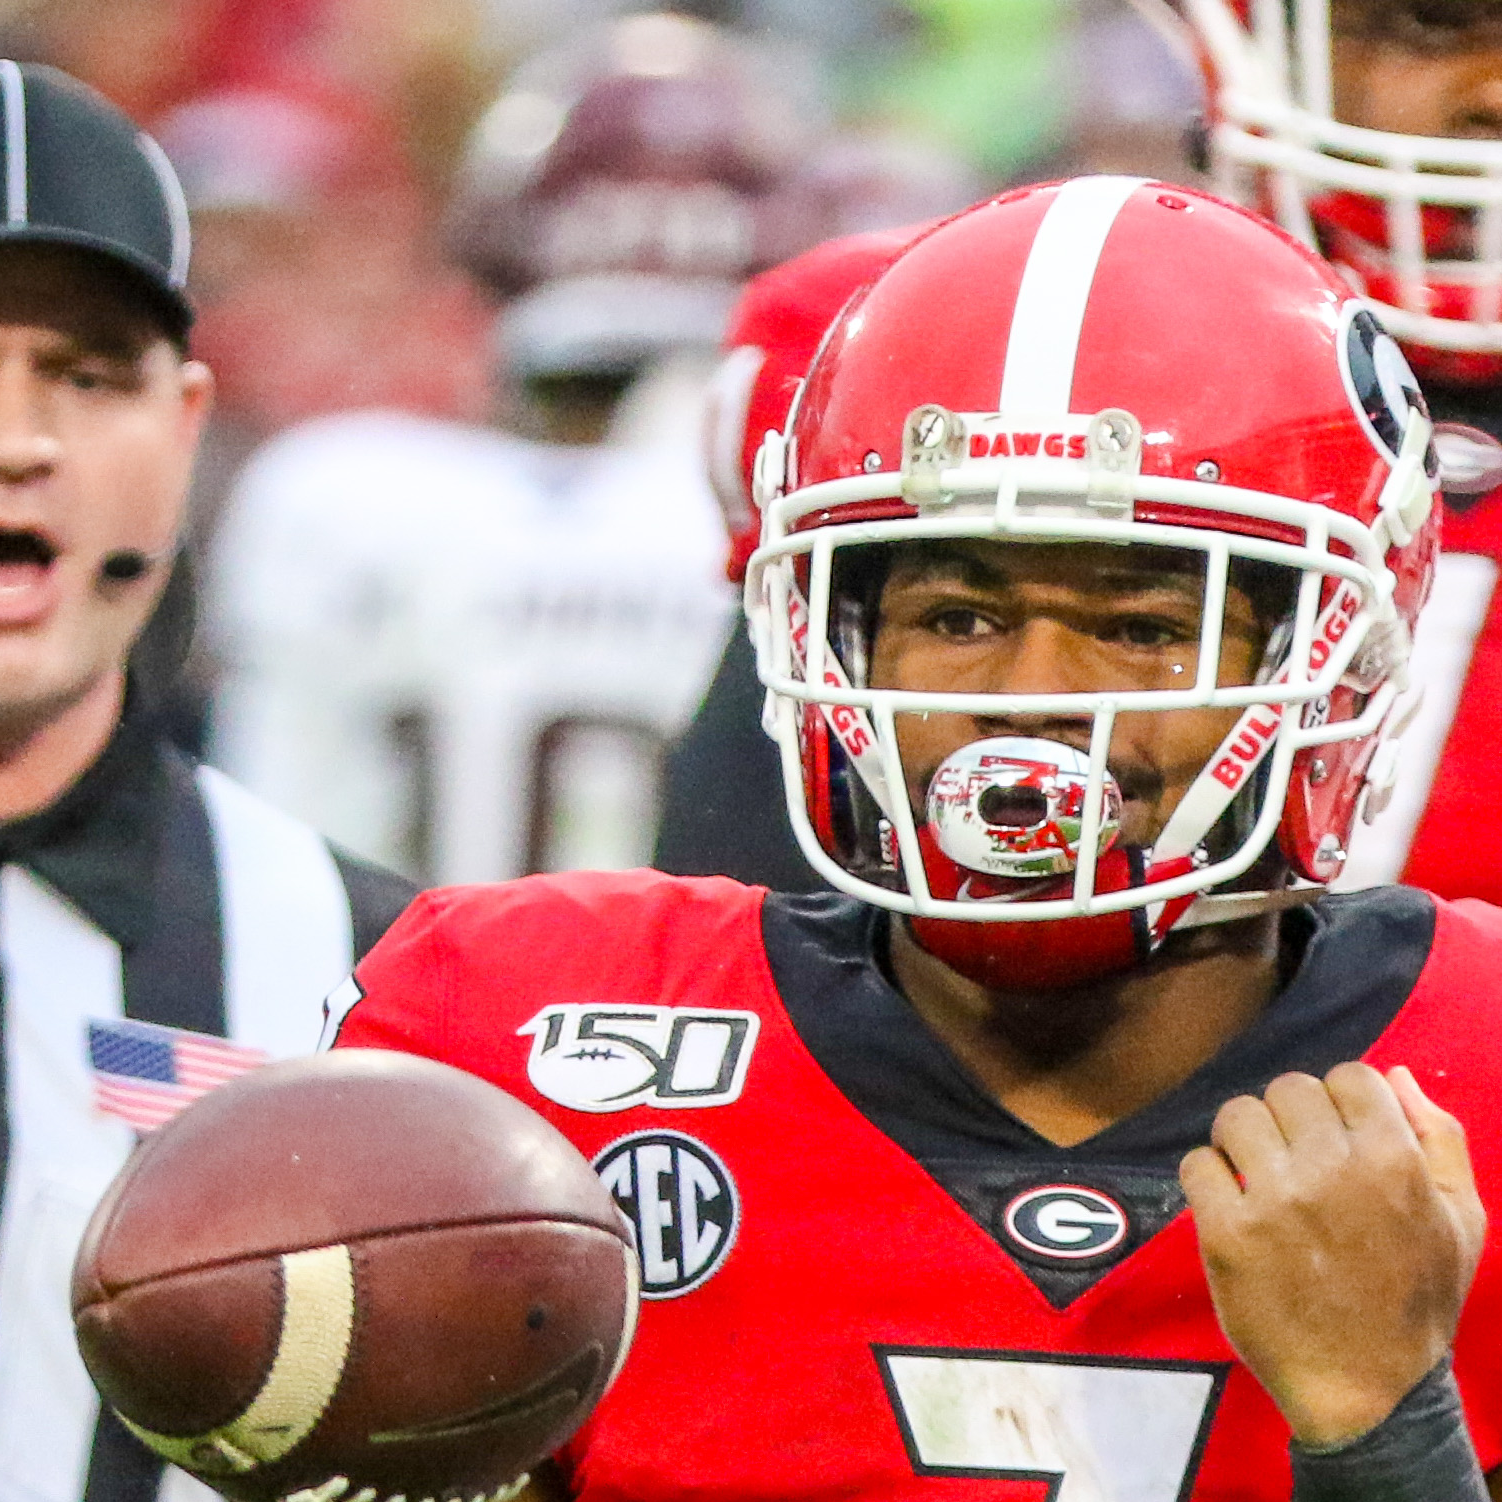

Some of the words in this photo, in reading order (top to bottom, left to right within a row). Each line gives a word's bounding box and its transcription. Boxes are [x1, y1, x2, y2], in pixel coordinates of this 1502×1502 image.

[969, 432, 1087, 459] DAWGS
[1210, 588, 1361, 790] BULOGS
[537, 1011, 752, 1103] 150
